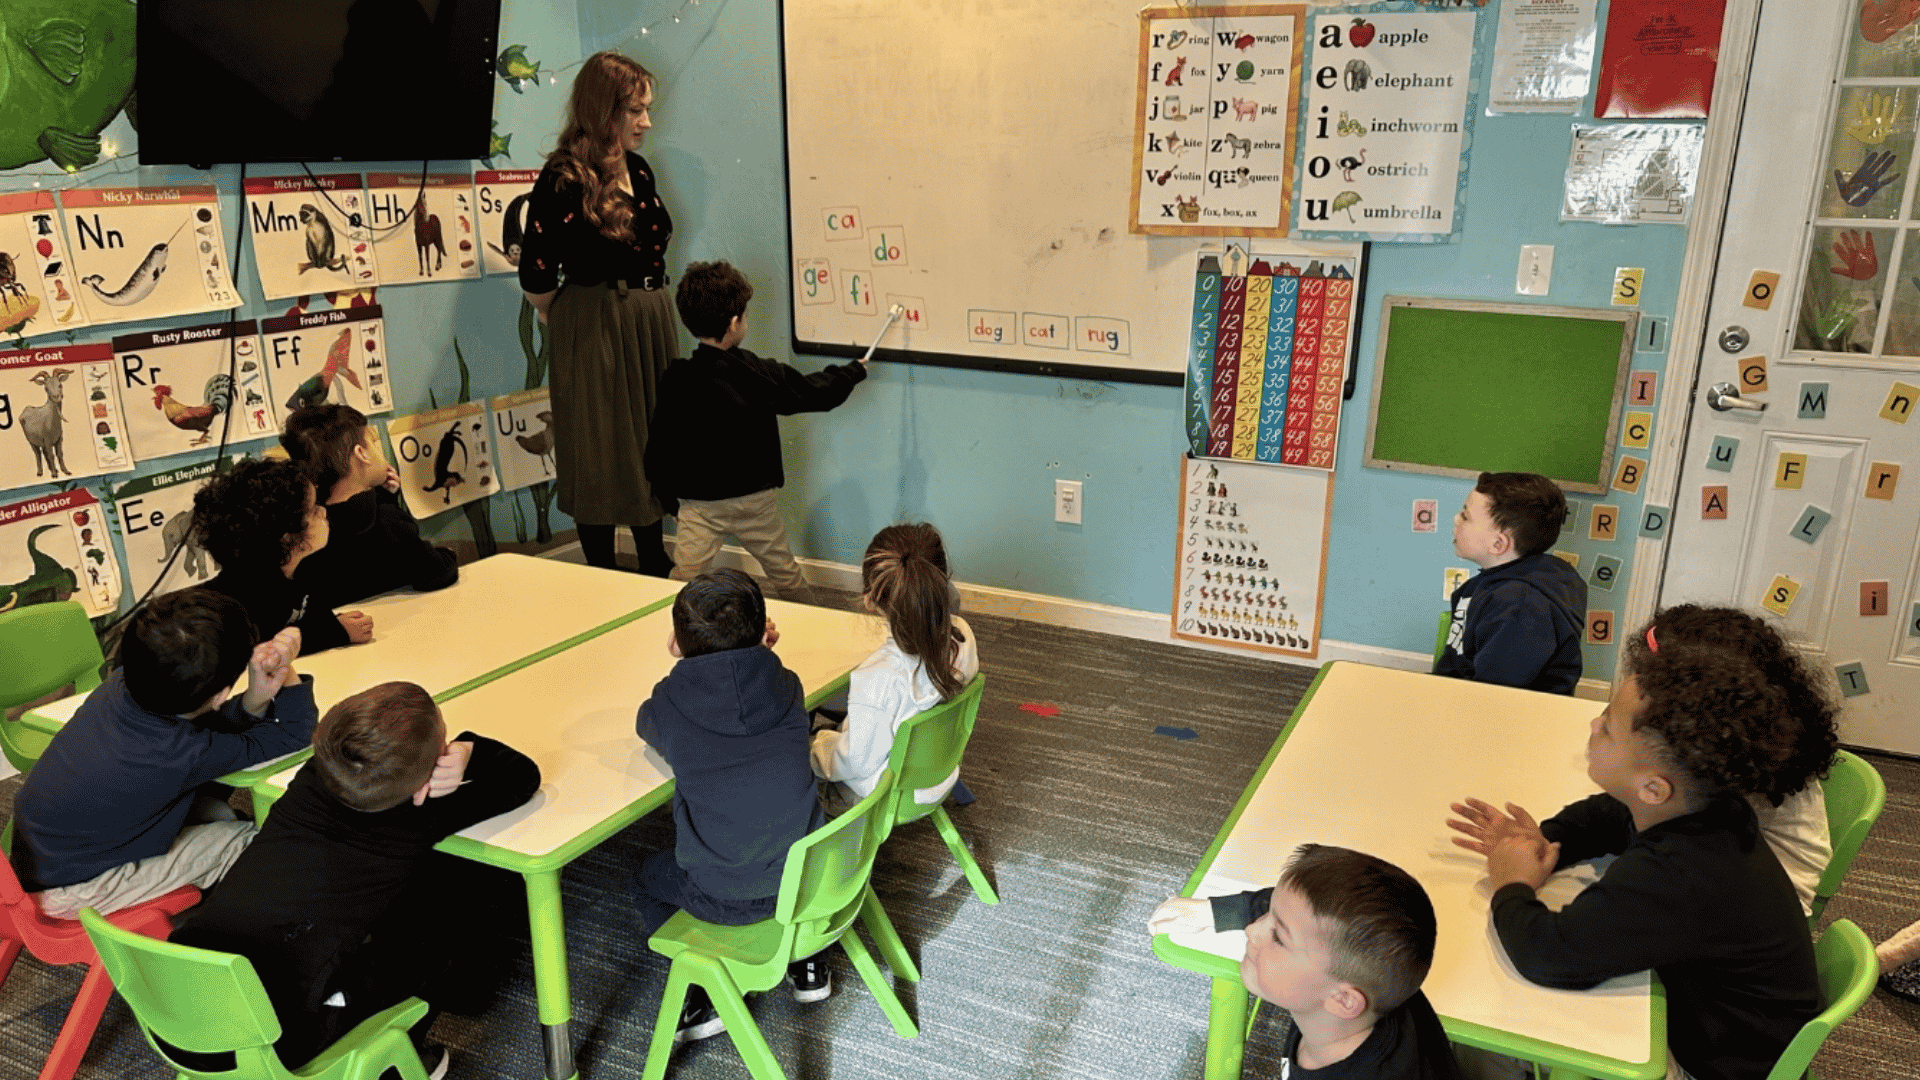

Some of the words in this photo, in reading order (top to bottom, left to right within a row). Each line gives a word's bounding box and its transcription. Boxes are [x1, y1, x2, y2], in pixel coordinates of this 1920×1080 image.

[1153, 33, 1164, 48] r
[1189, 36, 1209, 45] ring
[1217, 32, 1237, 45] w
[1256, 34, 1288, 43] wagon
[1319, 24, 1342, 48] a
[1379, 29, 1428, 46] apple
[1152, 62, 1162, 81] f
[1191, 67, 1205, 76] fox
[1216, 63, 1231, 81] y
[1260, 67, 1284, 75] yarn
[1316, 66, 1337, 89] e
[1375, 73, 1453, 90] elephant
[1149, 96, 1159, 120] j
[1190, 106, 1204, 115] jar
[1213, 100, 1227, 118] p
[1262, 104, 1277, 114] pig
[1316, 105, 1329, 138] i
[1371, 118, 1458, 133] inchworm
[1149, 133, 1162, 151] k
[1184, 139, 1202, 147] kite
[1211, 140, 1222, 152] z
[1253, 141, 1281, 149] zebra
[1146, 169, 1159, 182] v
[1174, 172, 1201, 180] violin
[1309, 156, 1330, 178] o
[1367, 163, 1428, 177] ostrich
[274, 179, 300, 190] Mickey
[103, 192, 130, 204] Nicky
[136, 189, 180, 200] Narwhal
[480, 186, 502, 213] Ss
[251, 201, 298, 233] Mm
[372, 194, 407, 222] Hh
[1161, 204, 1174, 217] x
[1305, 199, 1329, 220] u
[1364, 205, 1441, 219] umbrella
[76, 214, 124, 249] Nn
[827, 214, 856, 230] ca
[874, 233, 900, 261] do
[803, 267, 829, 297] ge
[851, 275, 870, 305] fi
[1225, 277, 1243, 291] 10
[1249, 278, 1270, 293] 20
[1275, 279, 1297, 294] 30
[1302, 280, 1323, 294] 40
[1328, 281, 1350, 296] 50
[1224, 296, 1240, 310] 11
[1274, 300, 1293, 313] 31
[1302, 300, 1320, 313] 41
[1327, 301, 1346, 315] 51
[300, 314, 327, 325] Freddy
[330, 311, 346, 321] Fish
[1222, 314, 1239, 328] 12
[1271, 318, 1293, 333] 32
[1298, 319, 1318, 334] 42
[1323, 320, 1346, 335] 52
[152, 332, 180, 344] Rusty
[184, 327, 221, 339] Rooster
[974, 318, 1002, 342] dog
[1030, 324, 1054, 338] cat
[1088, 327, 1118, 350] rug
[272, 336, 301, 368] Ff
[1220, 334, 1238, 347] 13
[1268, 337, 1291, 351] 33
[1296, 338, 1316, 352] 43
[1321, 339, 1344, 354] 53
[0, 355, 31, 364] omer
[35, 351, 64, 361] Goat
[1219, 352, 1236, 366] 14
[1267, 355, 1290, 369] 34
[1294, 357, 1314, 371] 44
[1320, 358, 1340, 373] 54
[122, 354, 161, 388] Rr
[1743, 365, 1766, 385] G
[1216, 370, 1235, 384] 15
[1265, 374, 1288, 388] 35
[1292, 376, 1309, 390] 45
[1317, 377, 1340, 392] 55
[1215, 388, 1232, 402] 16
[1264, 393, 1285, 406] 36
[1290, 394, 1307, 409] 46
[1315, 396, 1334, 410] 56
[1801, 392, 1825, 411] M
[1890, 396, 1909, 413] n
[497, 411, 526, 435] Uu
[1213, 406, 1231, 420] 17
[1237, 408, 1258, 421] 27
[1262, 410, 1282, 424] 37
[1288, 412, 1307, 426] 47
[1313, 414, 1335, 428] 57
[1211, 424, 1229, 437] 18
[1261, 428, 1280, 442] 38
[1285, 431, 1306, 444] 48
[1311, 432, 1332, 446] 58
[400, 436, 431, 462] Oo
[1211, 442, 1228, 455] 19
[1258, 446, 1279, 459] 39
[1285, 448, 1303, 462] 49
[1309, 451, 1331, 465] 59
[152, 474, 173, 487] Ellie
[175, 464, 215, 481] Elephant
[1621, 465, 1637, 484] B
[1784, 462, 1800, 481] F
[1878, 473, 1891, 488] r
[1190, 482, 1202, 494] 2
[21, 497, 71, 515] Alligator
[1190, 499, 1200, 512] 3
[1706, 493, 1723, 512] A
[122, 499, 164, 535] Ee
[1190, 517, 1199, 528] 4
[1417, 509, 1432, 523] a
[1597, 514, 1611, 532] R
[1645, 513, 1662, 531] D
[1802, 515, 1815, 535] L
[1187, 533, 1198, 546] 5
[1187, 551, 1196, 563] 6
[1186, 568, 1194, 579] 7
[1597, 567, 1613, 581] e
[1185, 585, 1194, 596] 8
[1184, 601, 1192, 613] 9
[1872, 591, 1876, 610] i
[1180, 619, 1194, 631] 10
[1592, 620, 1608, 640] g
[1844, 671, 1857, 688] T
